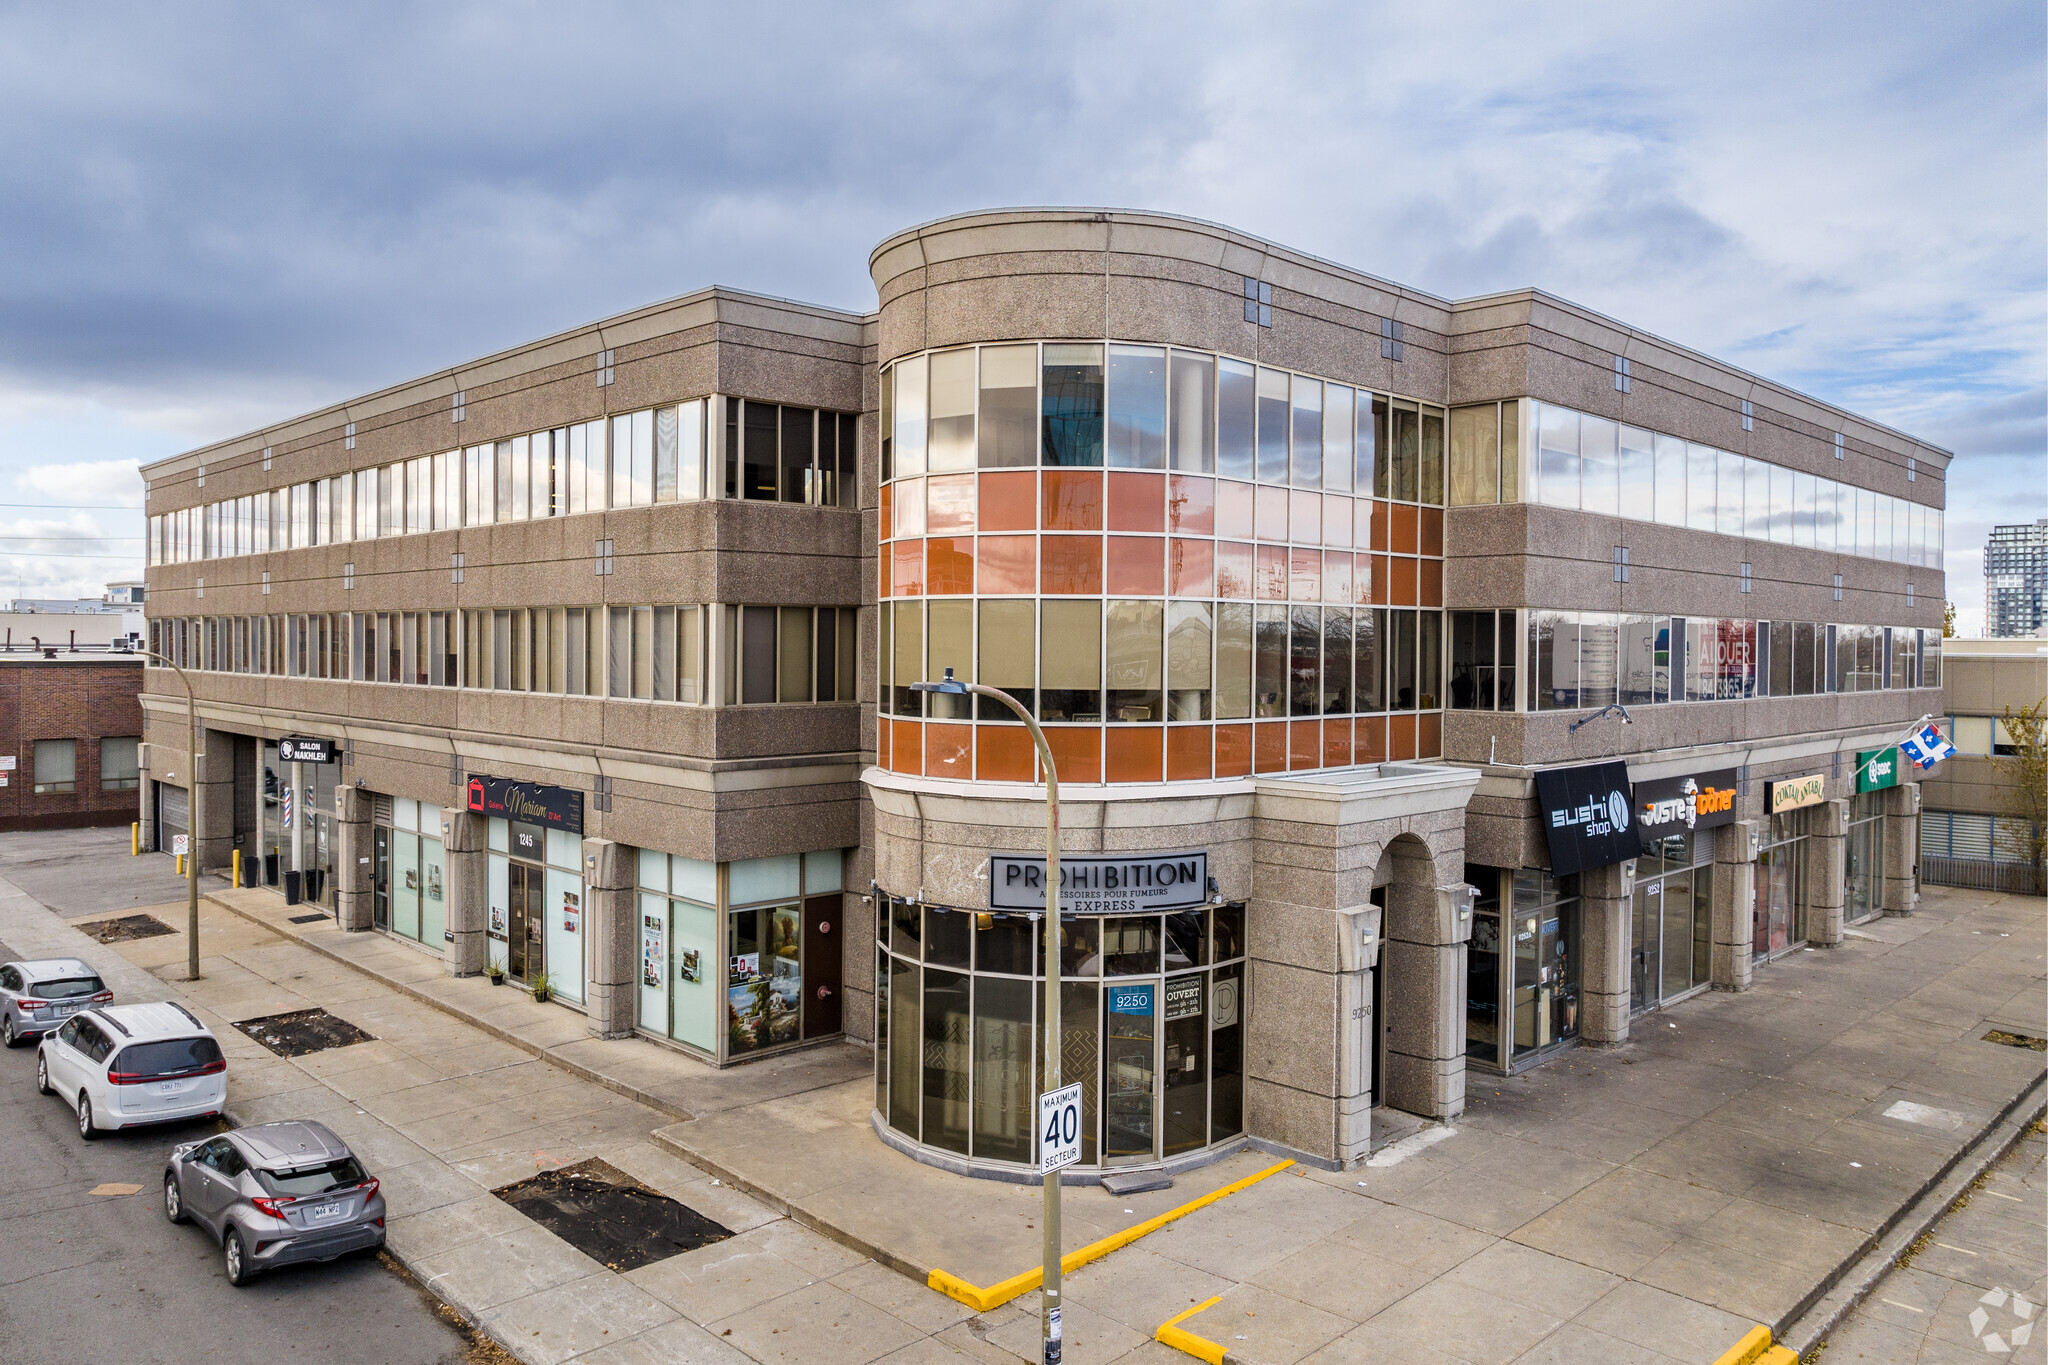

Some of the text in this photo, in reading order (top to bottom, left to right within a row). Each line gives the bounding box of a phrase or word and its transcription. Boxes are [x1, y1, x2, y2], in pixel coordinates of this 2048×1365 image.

[299, 742, 321, 751] SALON
[294, 750, 327, 761] NAKHLEH
[488, 800, 504, 811] Galerie
[504, 784, 547, 818] Mariam
[1551, 794, 1608, 828] sushi
[1586, 820, 1611, 837] shop
[519, 832, 533, 848] 1245
[1039, 888, 1169, 899] AESSOIRES POUR FUMEURS
[1075, 900, 1136, 912] EXPRESS
[1116, 995, 1148, 1008] 9250
[1166, 987, 1200, 1002] OUVERT
[1352, 1004, 1372, 1020] 9250
[1044, 1089, 1078, 1110] MAXIMUM
[1044, 1104, 1078, 1149] 40
[1045, 1147, 1077, 1168] SECTEUR
